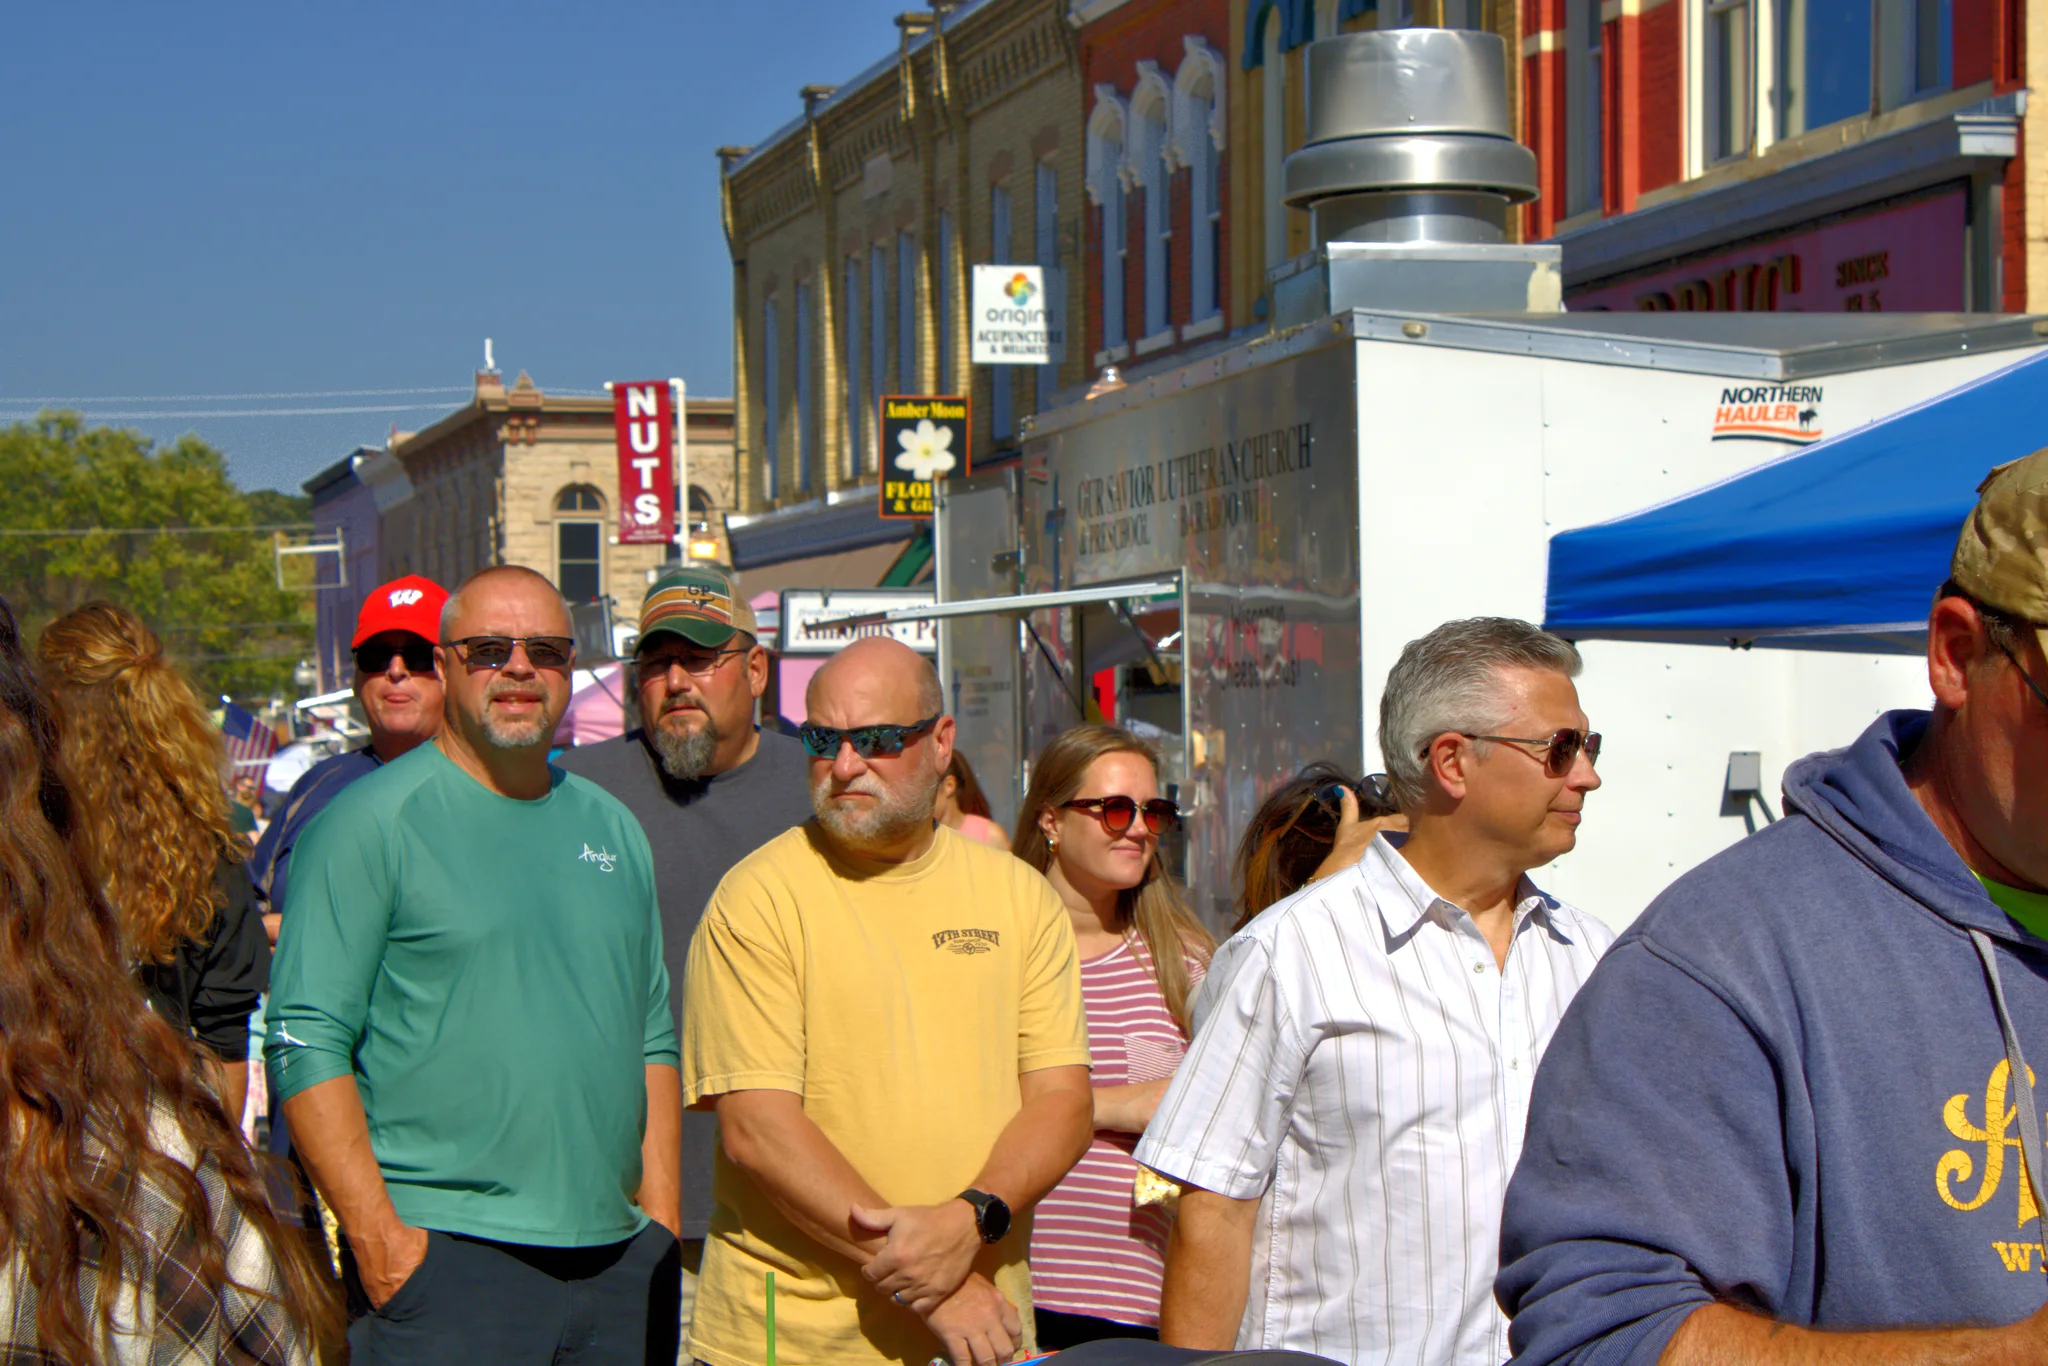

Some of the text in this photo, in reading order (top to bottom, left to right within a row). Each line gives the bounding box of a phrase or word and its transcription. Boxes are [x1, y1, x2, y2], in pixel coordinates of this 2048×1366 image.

[986, 308, 1055, 327] origin
[977, 330, 1063, 343] ACUPUNCTURE
[1720, 385, 1823, 404] NORTHERN
[886, 401, 965, 418] Amber Moon
[1715, 404, 1798, 423] HAULER
[626, 385, 662, 526] NUTS
[1077, 423, 1312, 519] OUR SAVIOR LUTHERAN CHURCH
[688, 584, 711, 596] GP
[961, 928, 1000, 947] STREET
